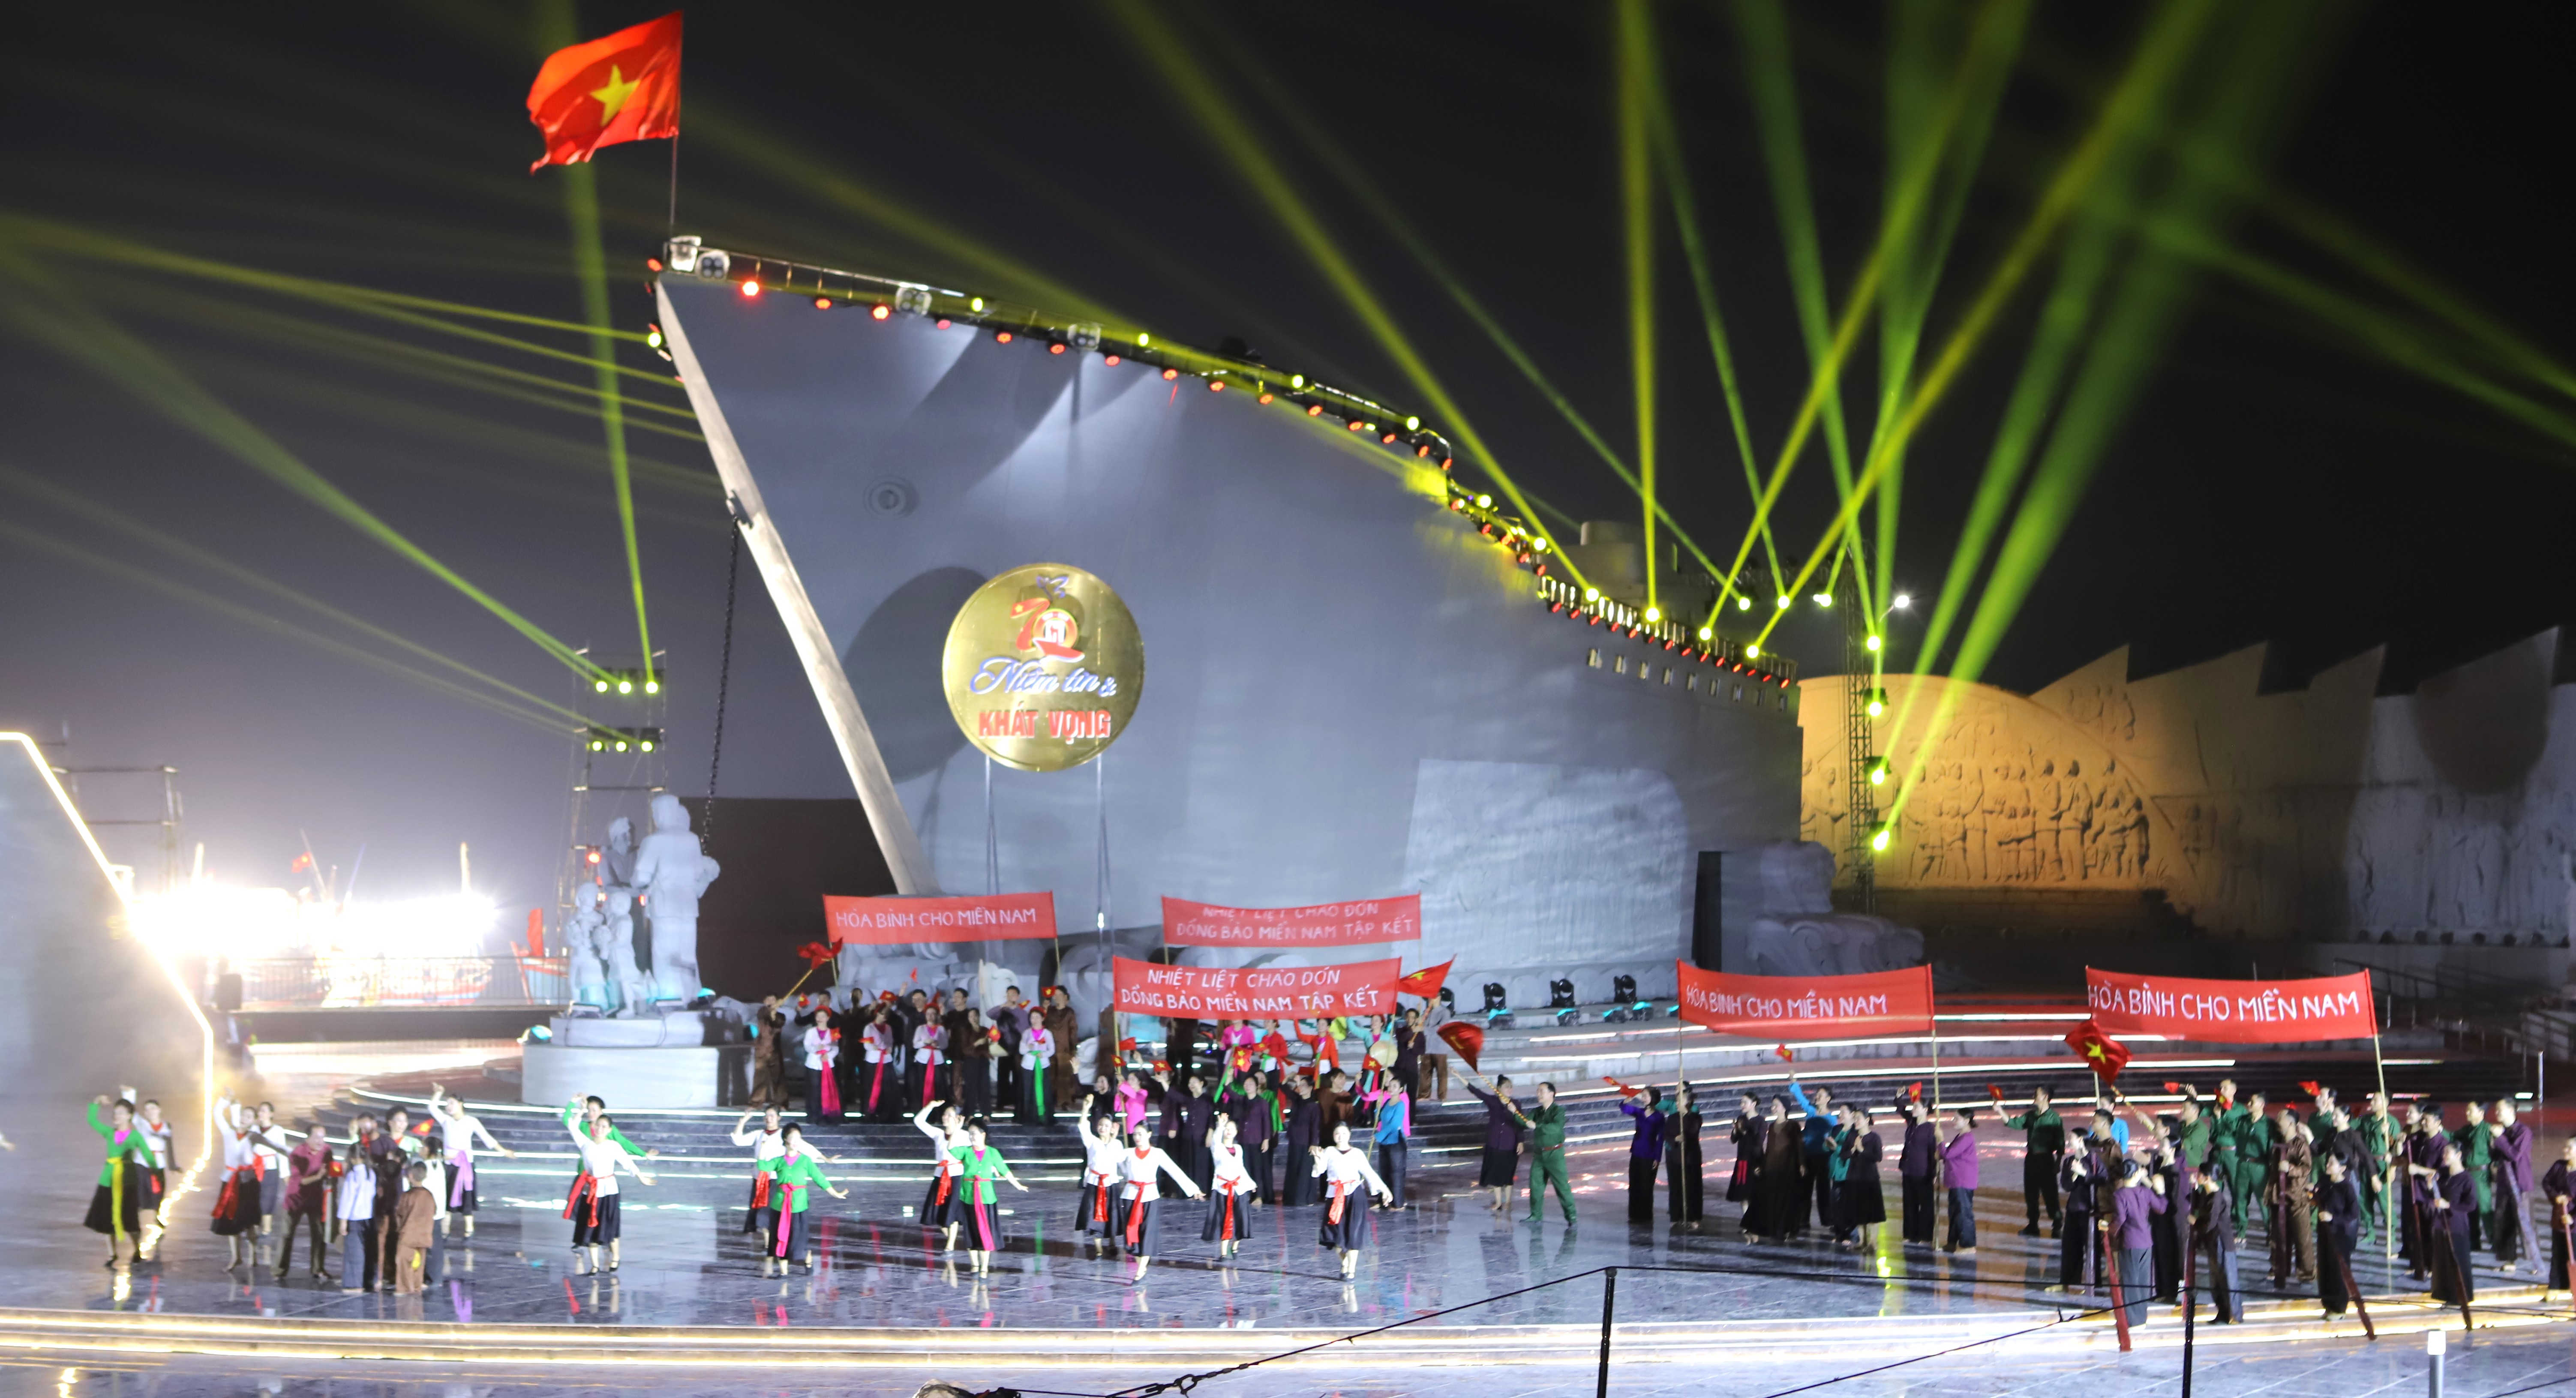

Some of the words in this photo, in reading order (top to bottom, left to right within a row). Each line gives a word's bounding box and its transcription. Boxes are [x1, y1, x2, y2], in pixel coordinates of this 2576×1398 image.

[1063, 668, 1100, 693] tin
[979, 701, 1038, 739] KHÁT
[1048, 709, 1111, 745] VỌNG
[836, 908, 873, 928] HÒA
[876, 908, 914, 928] BÌNH
[919, 911, 953, 926] CHO
[958, 906, 996, 925] MIỀN
[999, 908, 1036, 924] NAM
[1301, 926, 1336, 939] NAM
[1344, 920, 1375, 939] TẬP
[1382, 914, 1413, 934] KẾT
[1147, 967, 1196, 990] NHIỆT
[1201, 969, 1239, 991] LIỆT
[1206, 990, 1249, 1012] MIỀN
[1252, 997, 1292, 1011] NAM
[1299, 991, 1334, 1014] TẬP
[1343, 984, 1379, 1008] KẾT
[1747, 997, 1783, 1019] CHO
[1838, 993, 1888, 1017] NAM
[2088, 980, 2126, 1013] HÒA
[2129, 981, 2175, 1017] BÌNH
[2180, 993, 2230, 1021] CHO
[2237, 987, 2297, 1023] MIỀN
[2302, 990, 2360, 1019] NAM
